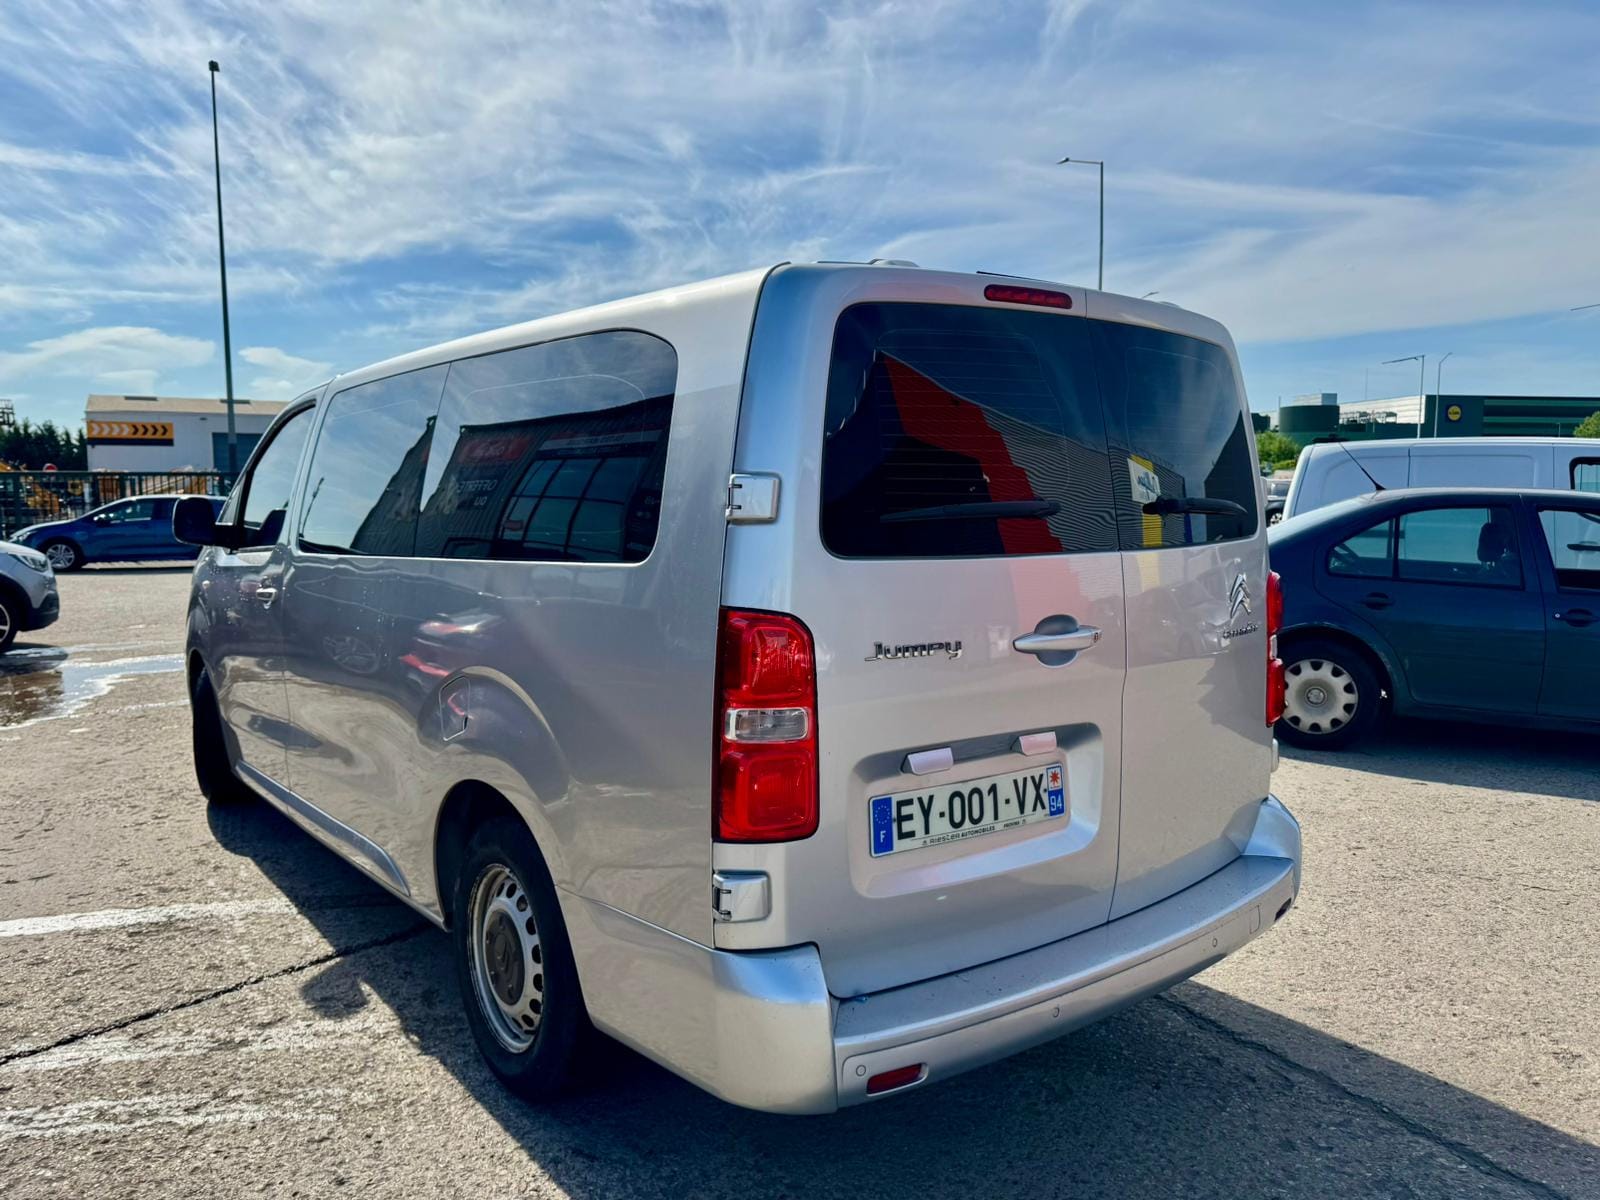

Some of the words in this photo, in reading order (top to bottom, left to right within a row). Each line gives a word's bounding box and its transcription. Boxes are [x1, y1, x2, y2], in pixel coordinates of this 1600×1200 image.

[864, 640, 963, 662] Jumpy
[1050, 795, 1062, 811] 94
[880, 830, 887, 843] F
[961, 825, 995, 838] AUTOMOBILES
